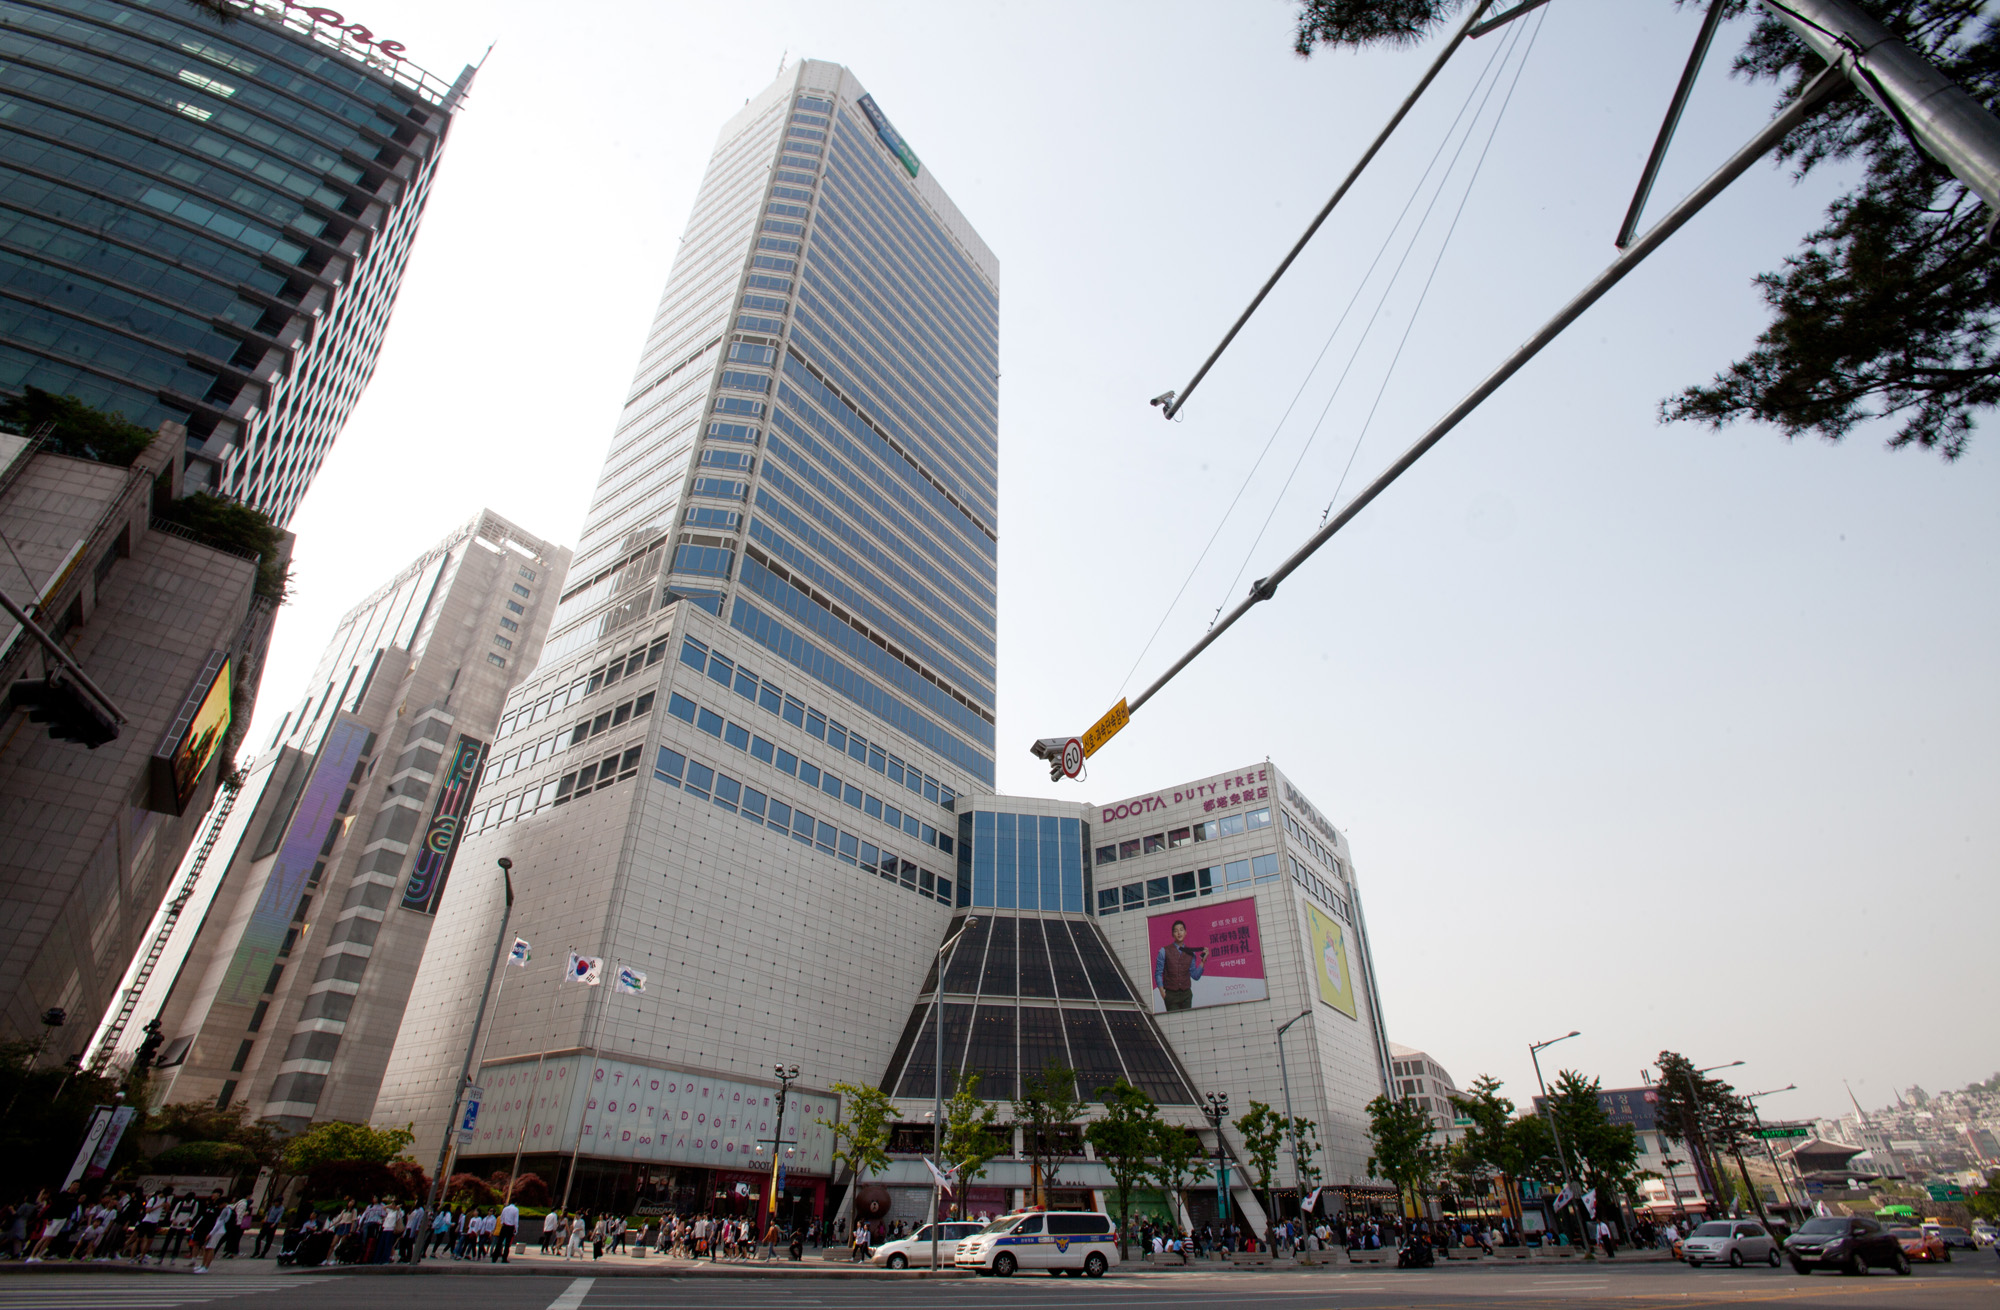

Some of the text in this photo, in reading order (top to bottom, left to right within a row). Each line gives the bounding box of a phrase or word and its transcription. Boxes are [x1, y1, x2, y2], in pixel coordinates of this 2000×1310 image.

[861, 99, 919, 167] DOOSAN
[1065, 746, 1079, 770] 60
[1102, 769, 1267, 823] DOOTA DUTY FREE
